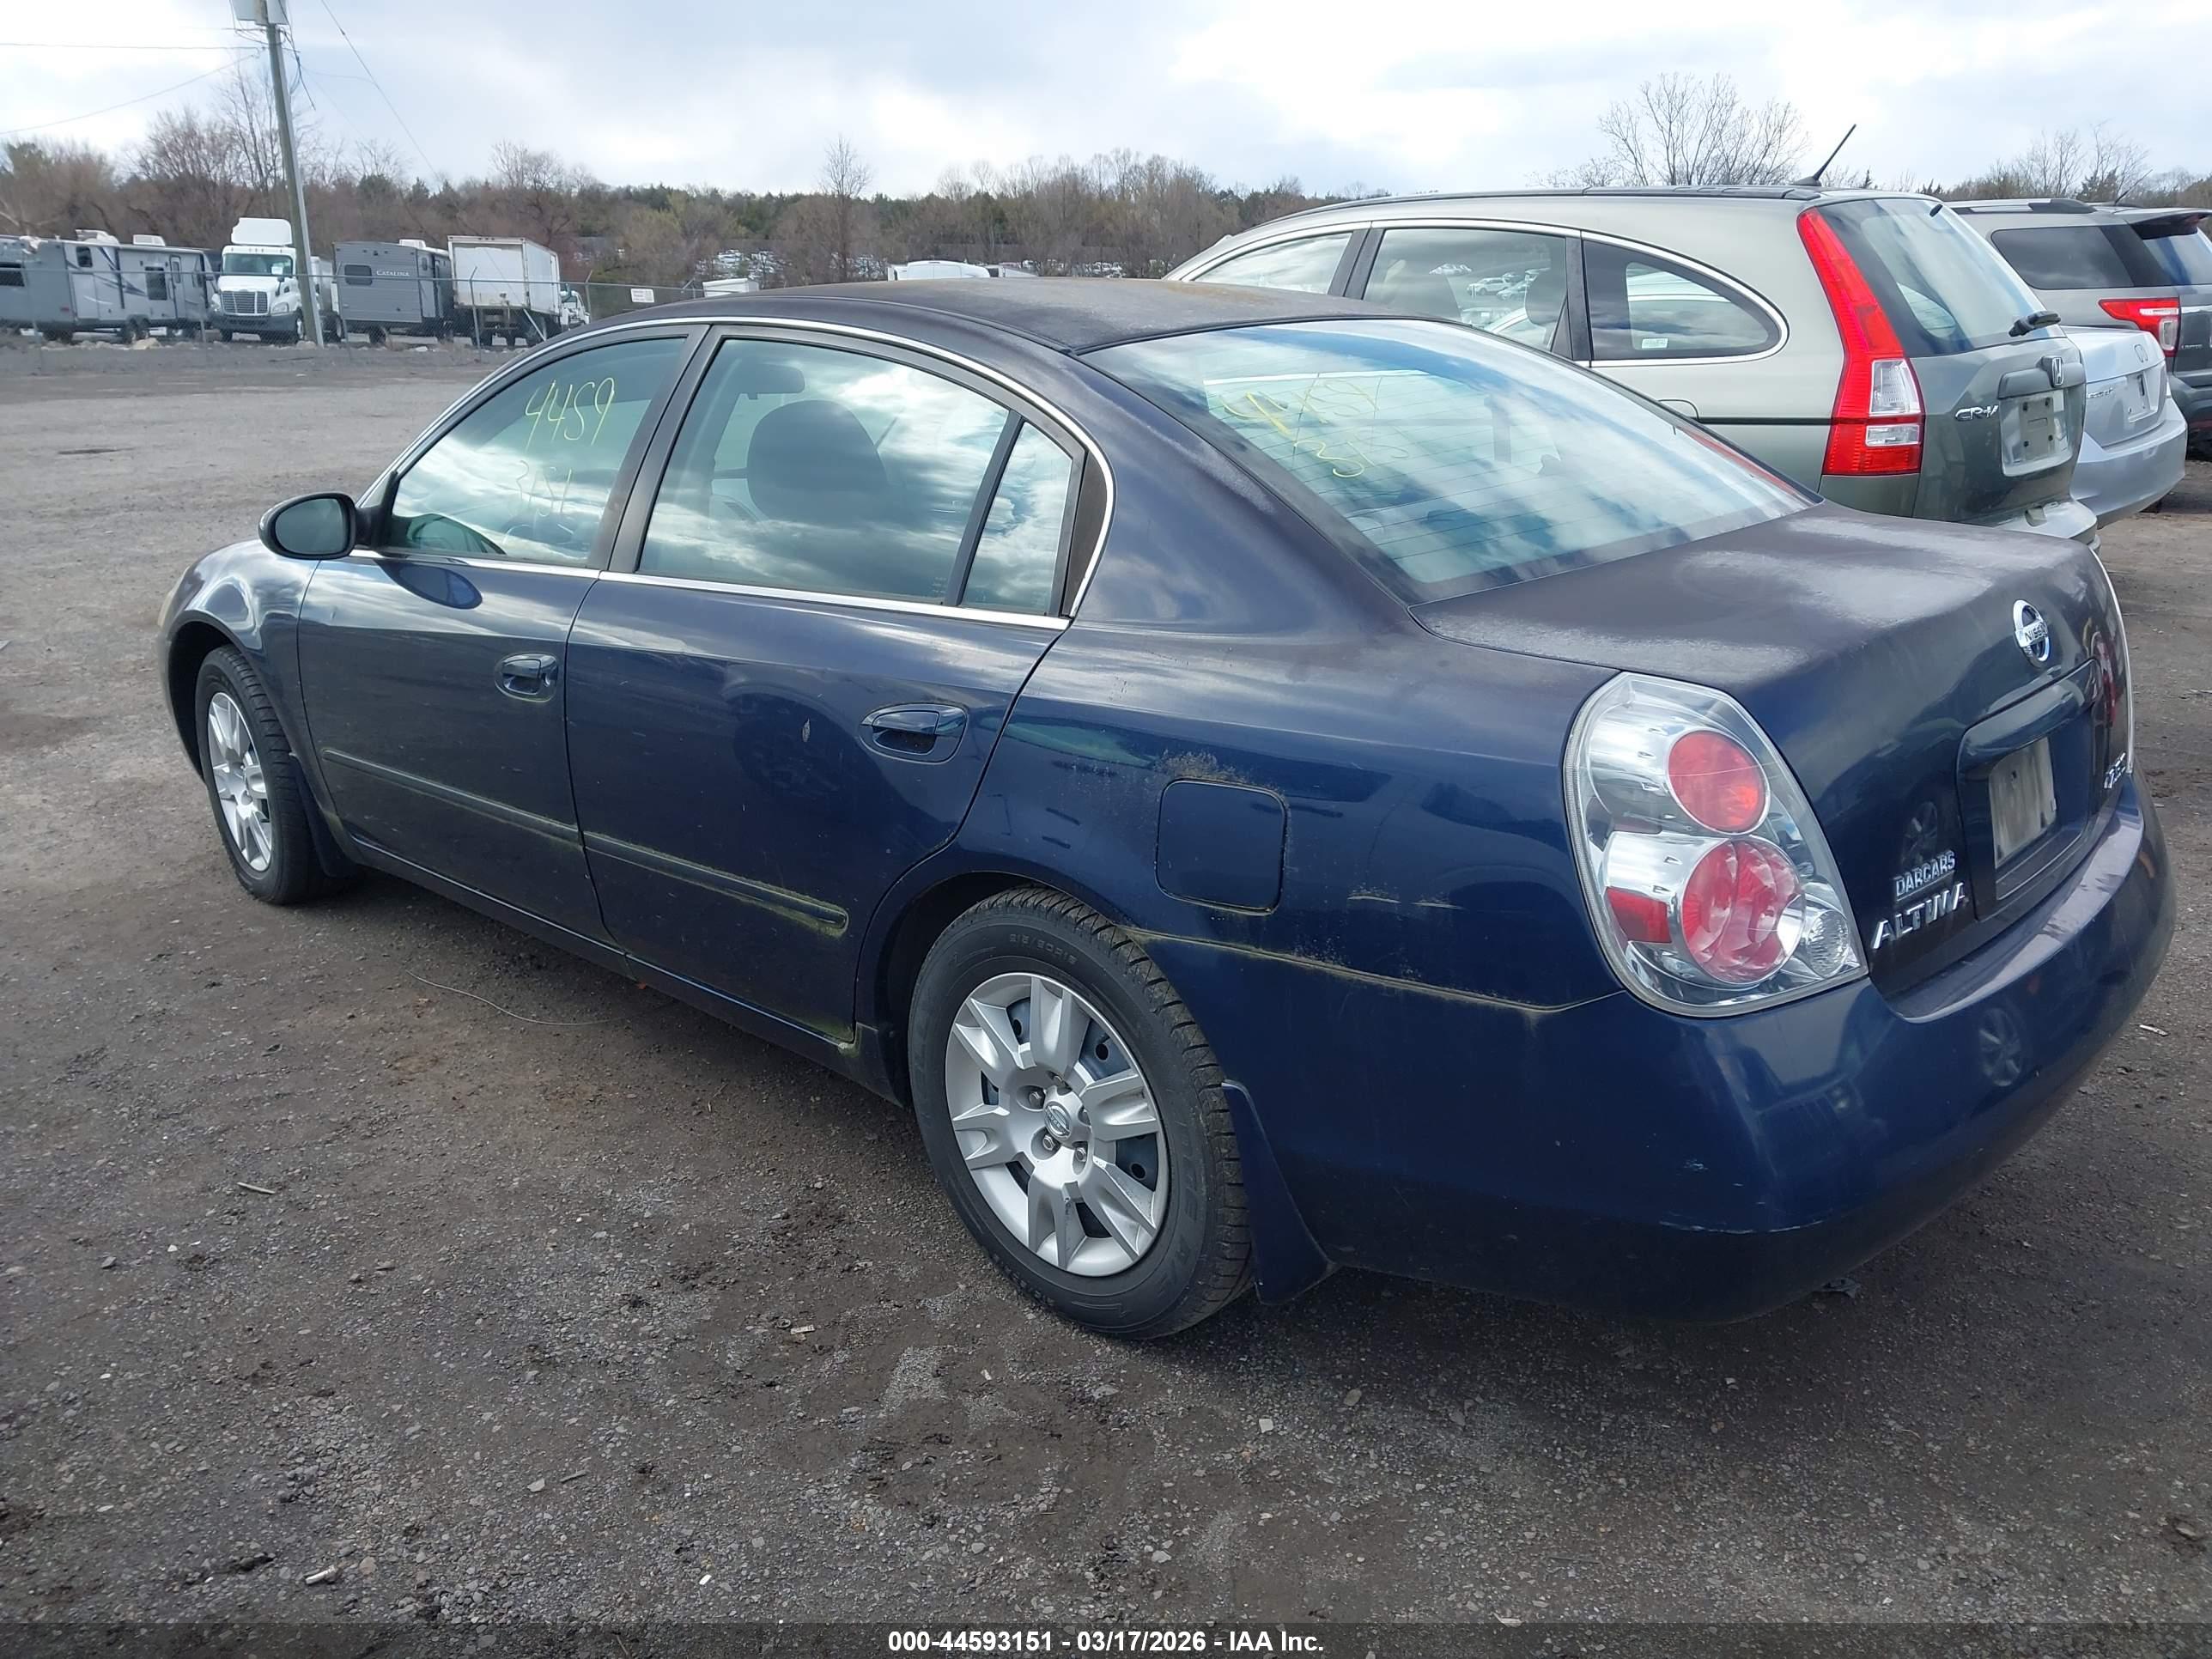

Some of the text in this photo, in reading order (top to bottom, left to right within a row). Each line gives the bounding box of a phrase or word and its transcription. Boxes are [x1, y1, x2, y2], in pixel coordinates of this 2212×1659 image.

[525, 378, 615, 453] 4459
[1954, 404, 1999, 421] CR-V
[1893, 849, 1956, 897] DARCARS
[1871, 881, 1969, 950] ALTIMA
